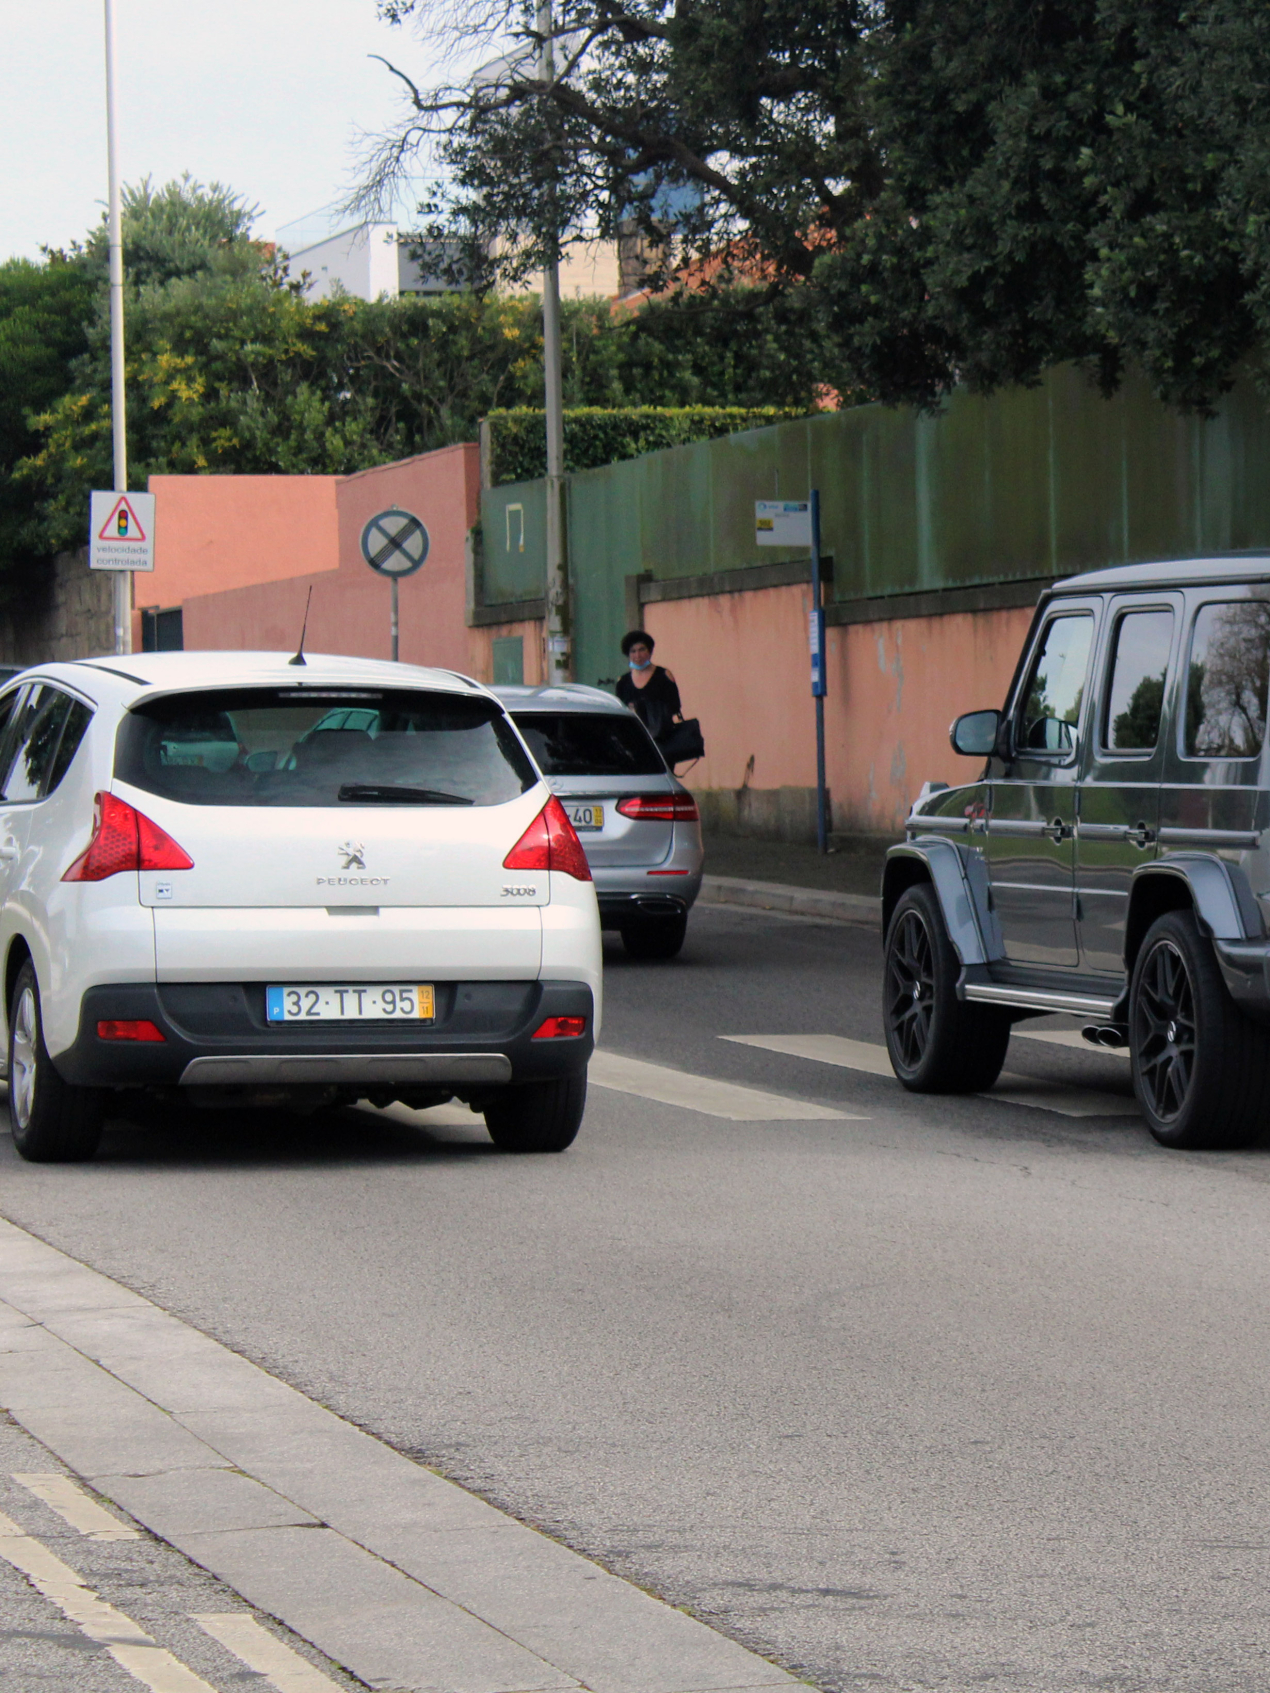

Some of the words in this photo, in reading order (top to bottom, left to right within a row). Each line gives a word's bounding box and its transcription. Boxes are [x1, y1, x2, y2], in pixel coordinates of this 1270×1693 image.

[96, 545, 149, 555] velocidade
[96, 557, 148, 567] controlada
[316, 876, 391, 886] PEUGEOT
[500, 885, 537, 897] 3008
[420, 990, 430, 1000] 12
[273, 1007, 280, 1015] P
[421, 1006, 429, 1015] 11
